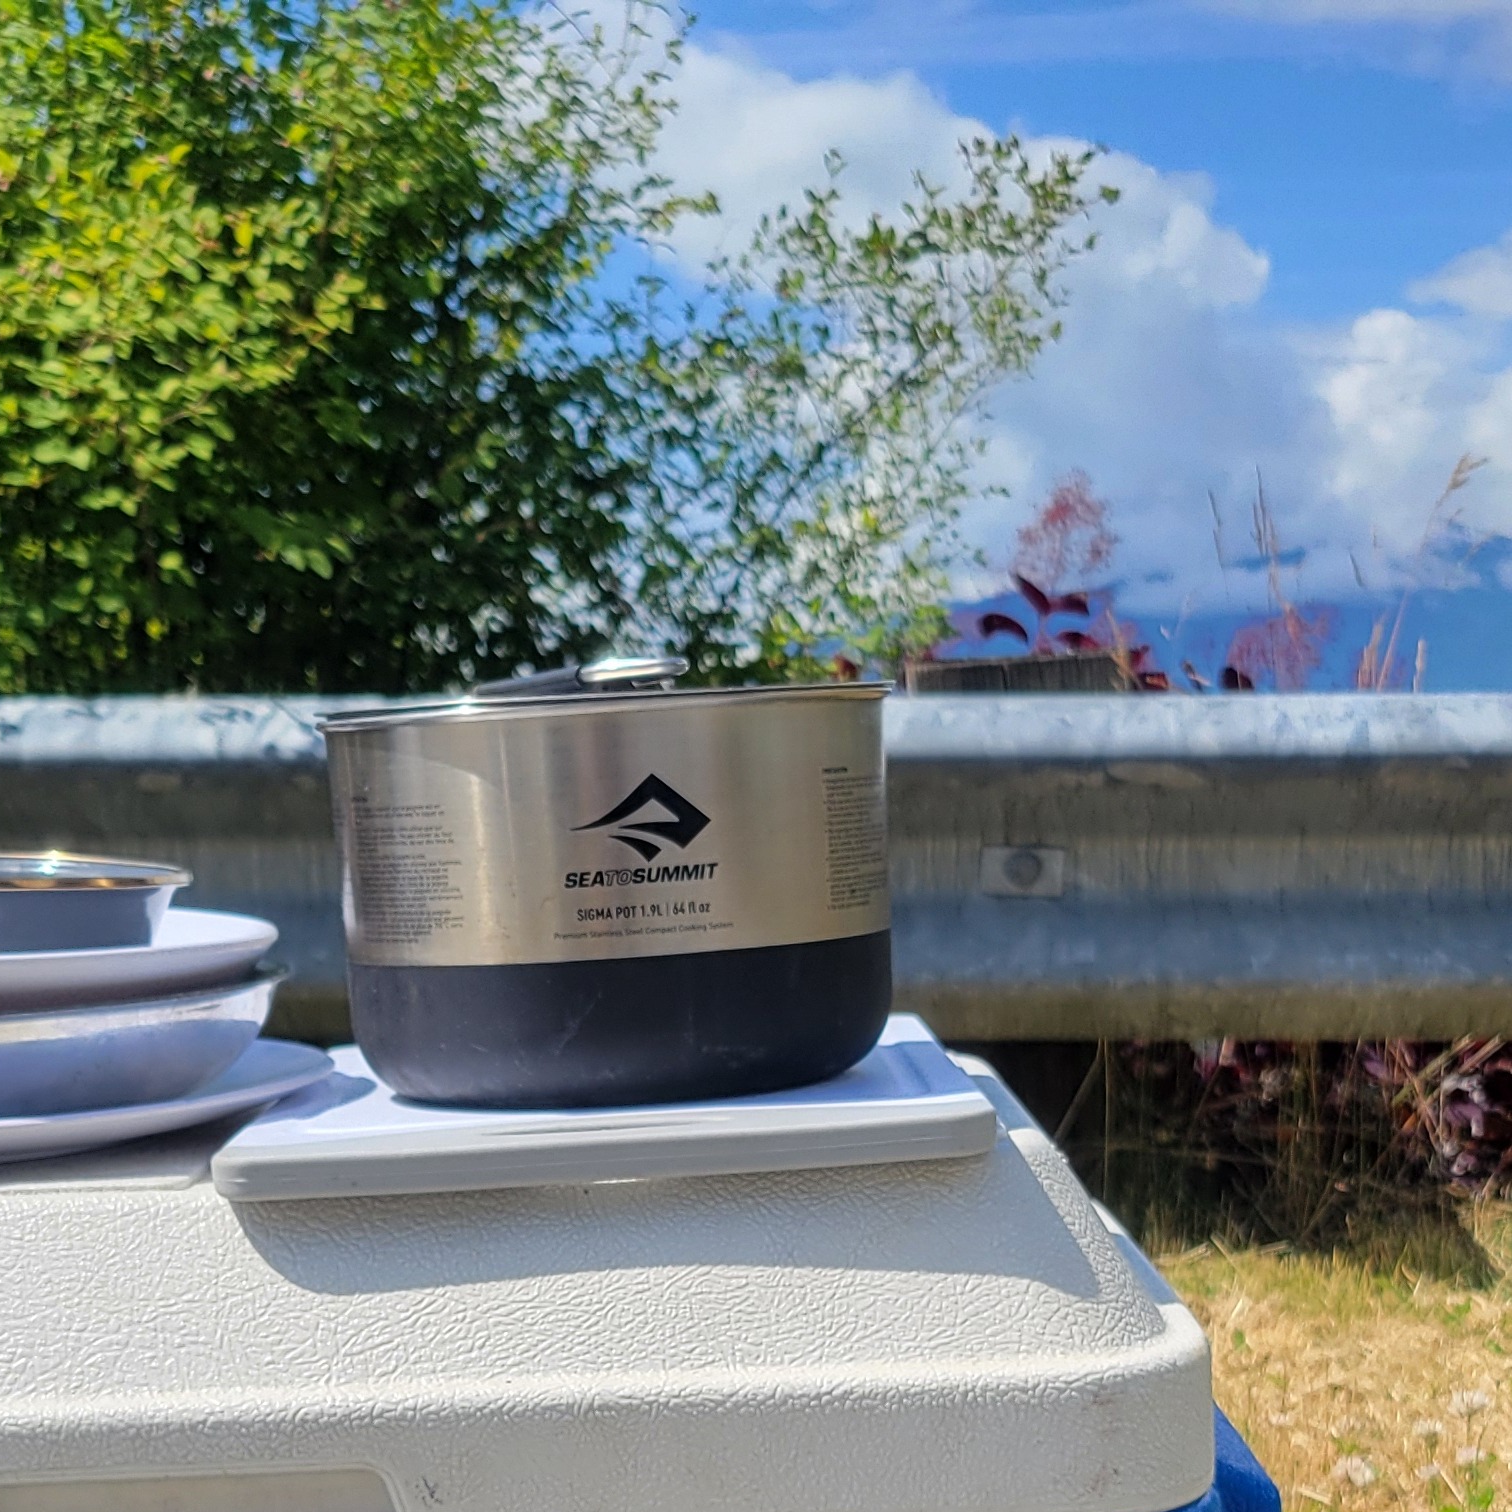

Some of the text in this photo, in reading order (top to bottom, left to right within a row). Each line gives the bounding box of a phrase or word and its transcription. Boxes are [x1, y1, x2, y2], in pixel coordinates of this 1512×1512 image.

[577, 907, 612, 921] SIGMA
[616, 906, 636, 919] POT
[641, 904, 662, 917] 1.9L
[672, 903, 685, 915] 64
[688, 902, 696, 914] fl
[699, 903, 711, 913] oz
[553, 921, 734, 941] Premium Stainless Steel Compact Cooking System
